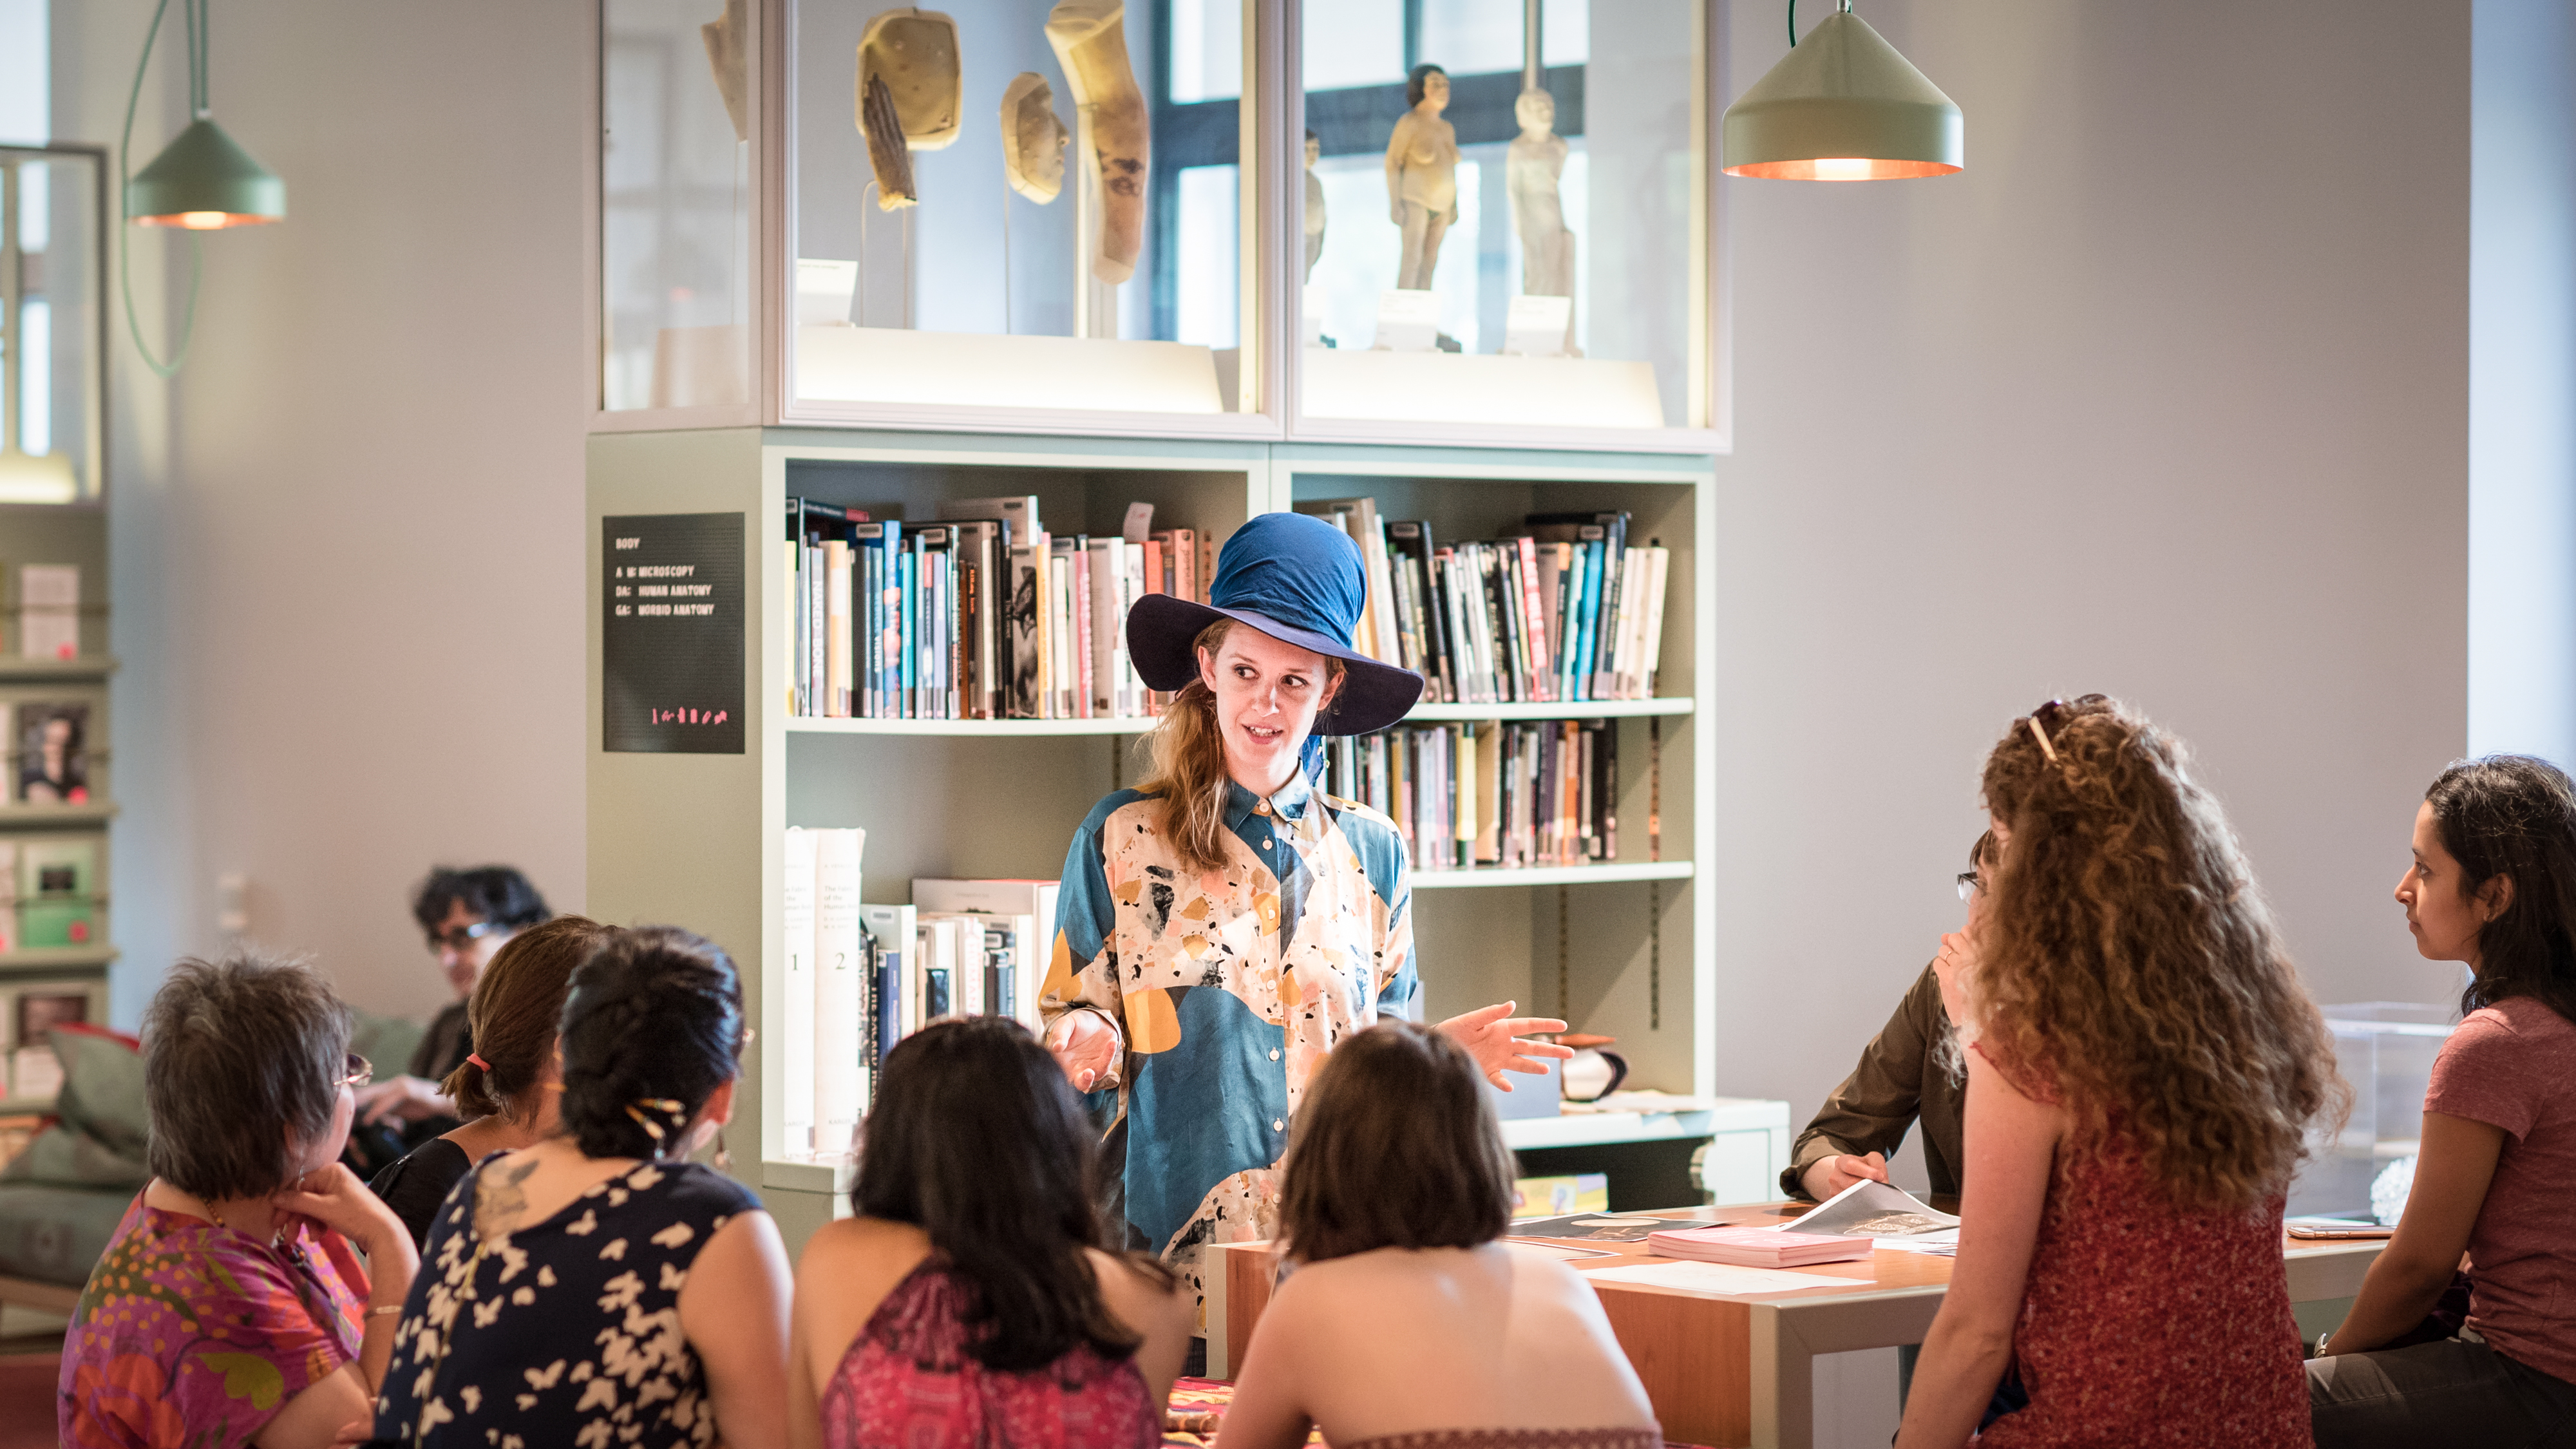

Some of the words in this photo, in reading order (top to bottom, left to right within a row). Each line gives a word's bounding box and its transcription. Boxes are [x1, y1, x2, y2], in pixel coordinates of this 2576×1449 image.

[616, 538, 640, 549] BODY
[638, 565, 695, 578] MICROSCOPY
[616, 585, 631, 597] DA:
[638, 585, 668, 596] HUMAN
[670, 585, 712, 596] ANATOMY
[616, 604, 632, 616] GA:
[638, 604, 671, 616] MORBID
[673, 603, 715, 616] ANATOMY
[812, 580, 823, 629] NAKED
[812, 638, 823, 678] BONE
[791, 953, 798, 971] 1
[835, 952, 846, 970] 2
[967, 943, 976, 1008] HUMAN
